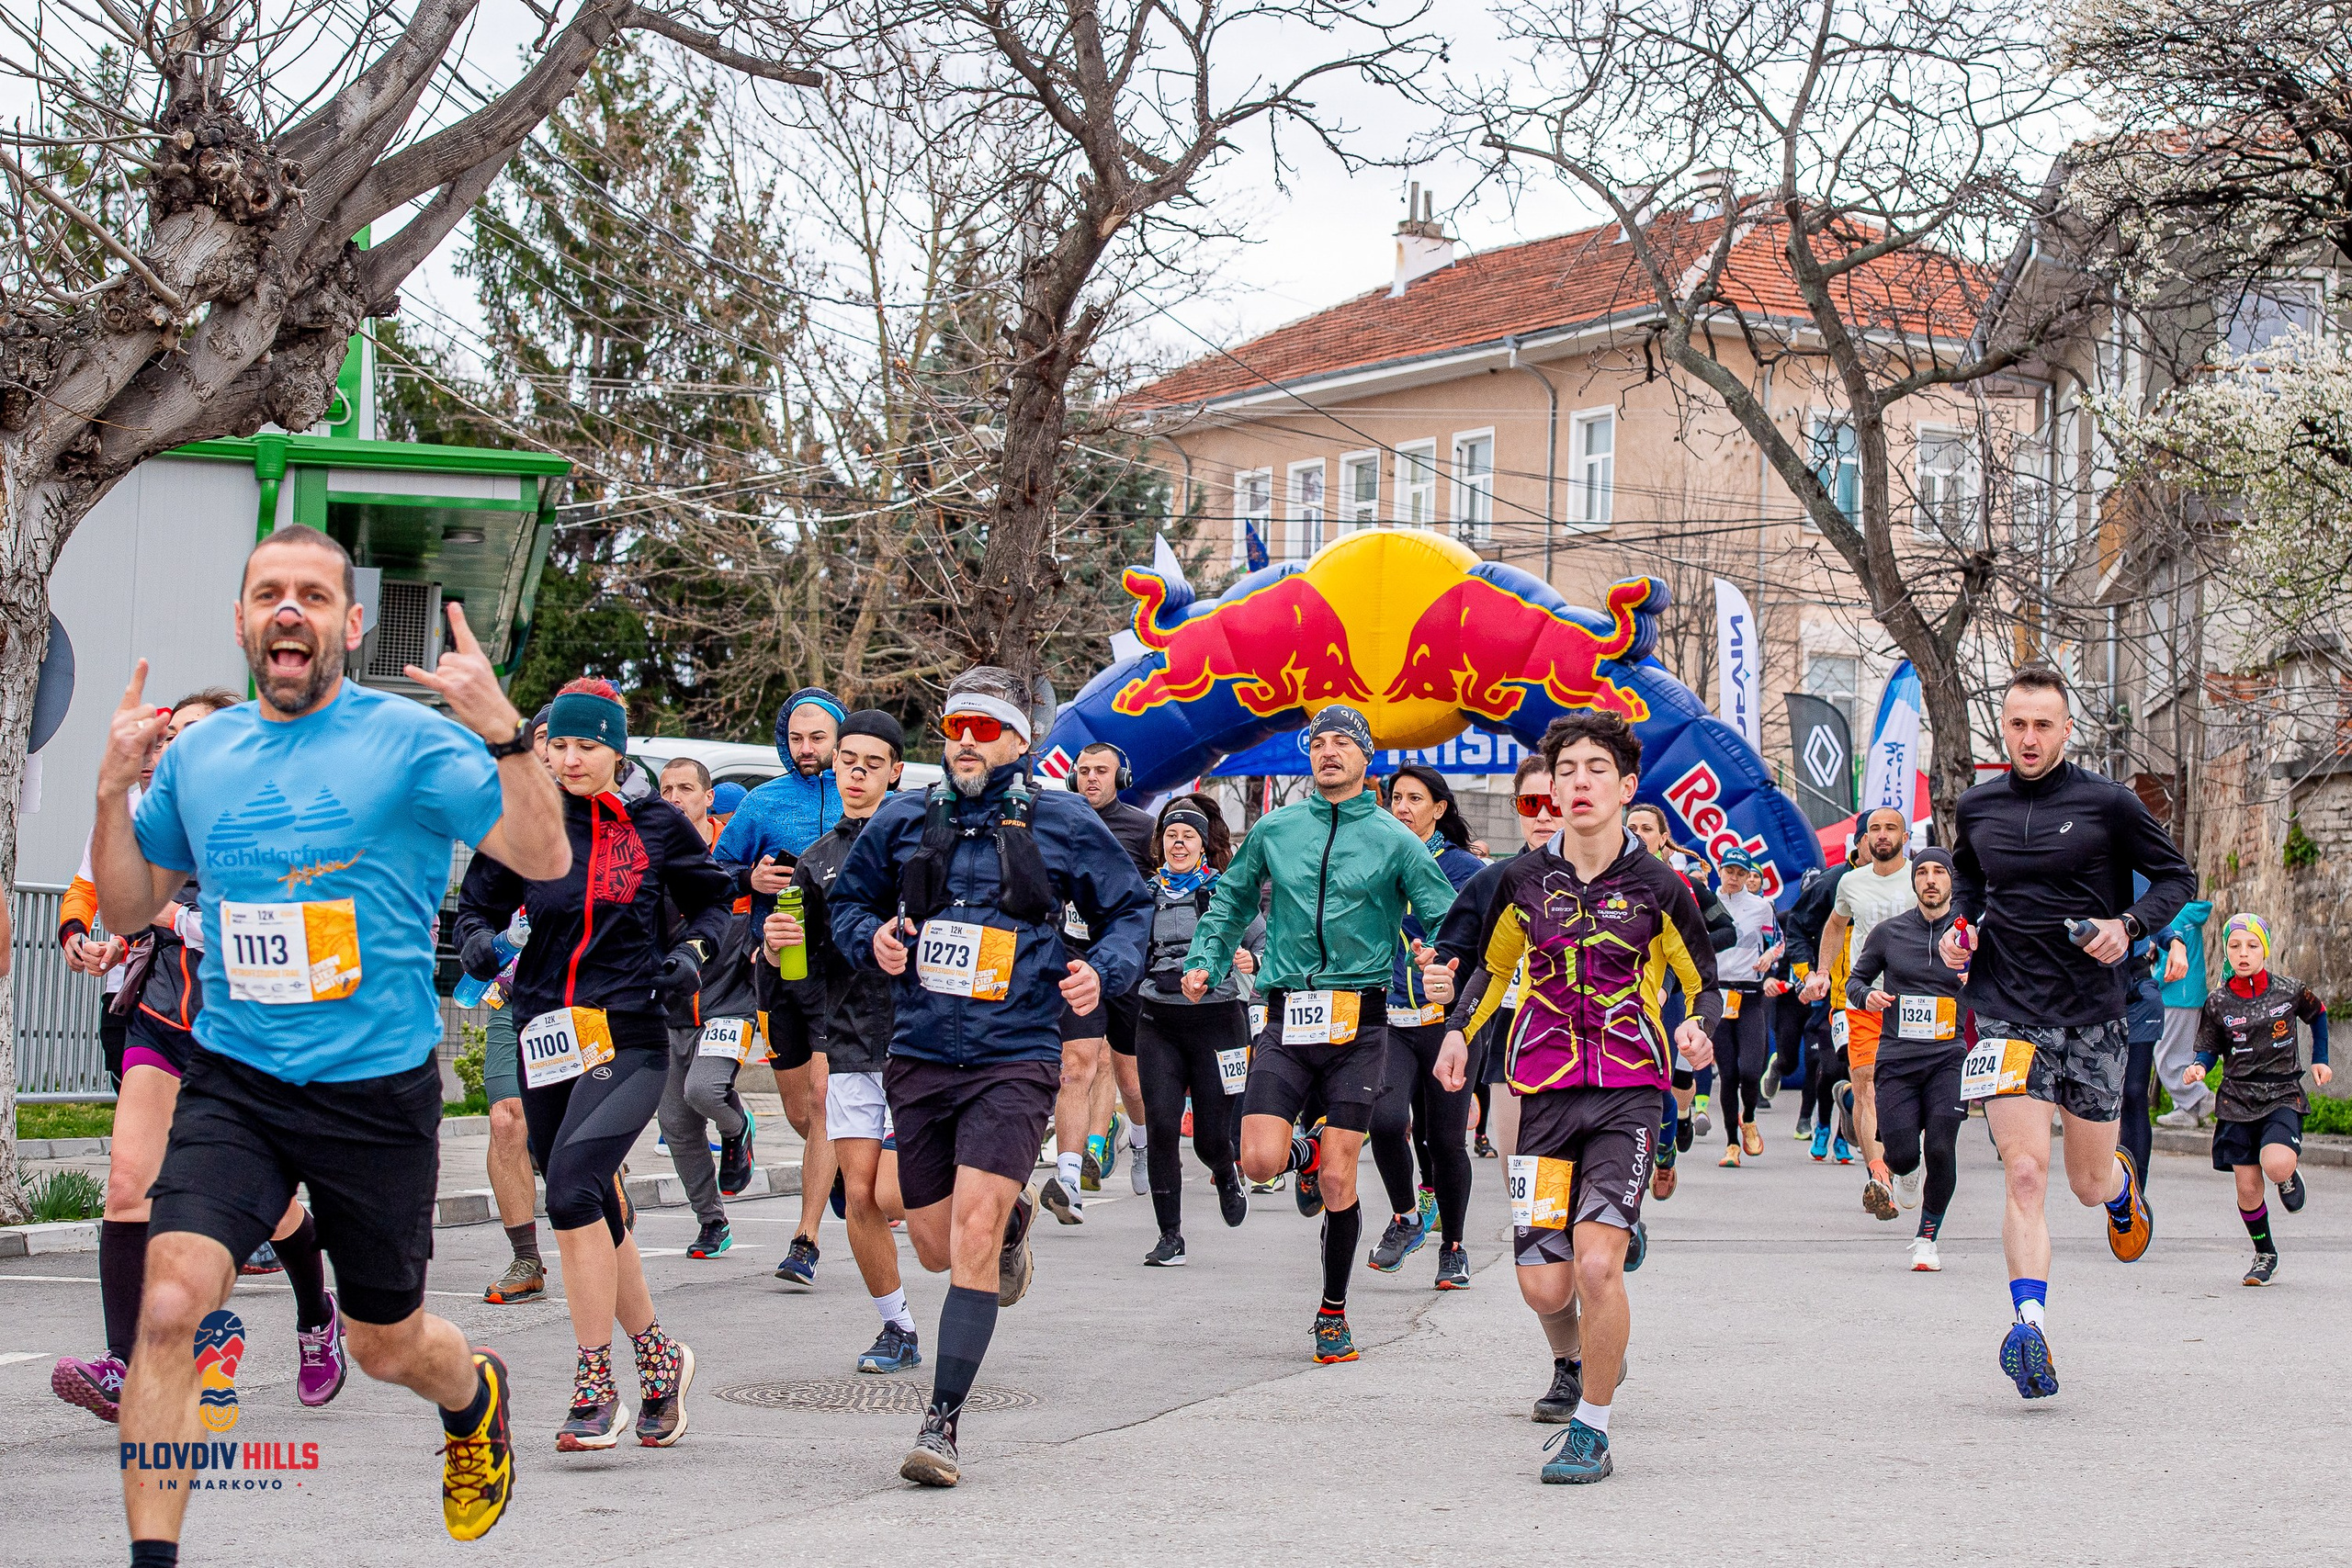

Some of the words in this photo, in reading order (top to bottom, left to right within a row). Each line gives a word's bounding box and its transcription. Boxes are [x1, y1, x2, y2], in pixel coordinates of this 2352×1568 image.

[1365, 722, 1530, 765] NISH
[1001, 819, 1026, 828] KIPRUN
[1664, 761, 1766, 868] Red
[257, 910, 275, 920] 12K
[950, 925, 963, 935] 12K
[232, 934, 289, 965] 1113
[923, 941, 970, 967] 1273
[544, 1015, 556, 1025] 12K
[1290, 1006, 1324, 1025] 1152
[1902, 1008, 1932, 1023] 1324
[705, 1028, 737, 1043] 1364
[526, 1031, 570, 1061] 1100
[1222, 1061, 1246, 1078] 1285
[1966, 1055, 1996, 1077] 1224
[1622, 1126, 1648, 1209] BULGARIA
[1509, 1176, 1526, 1200] 38
